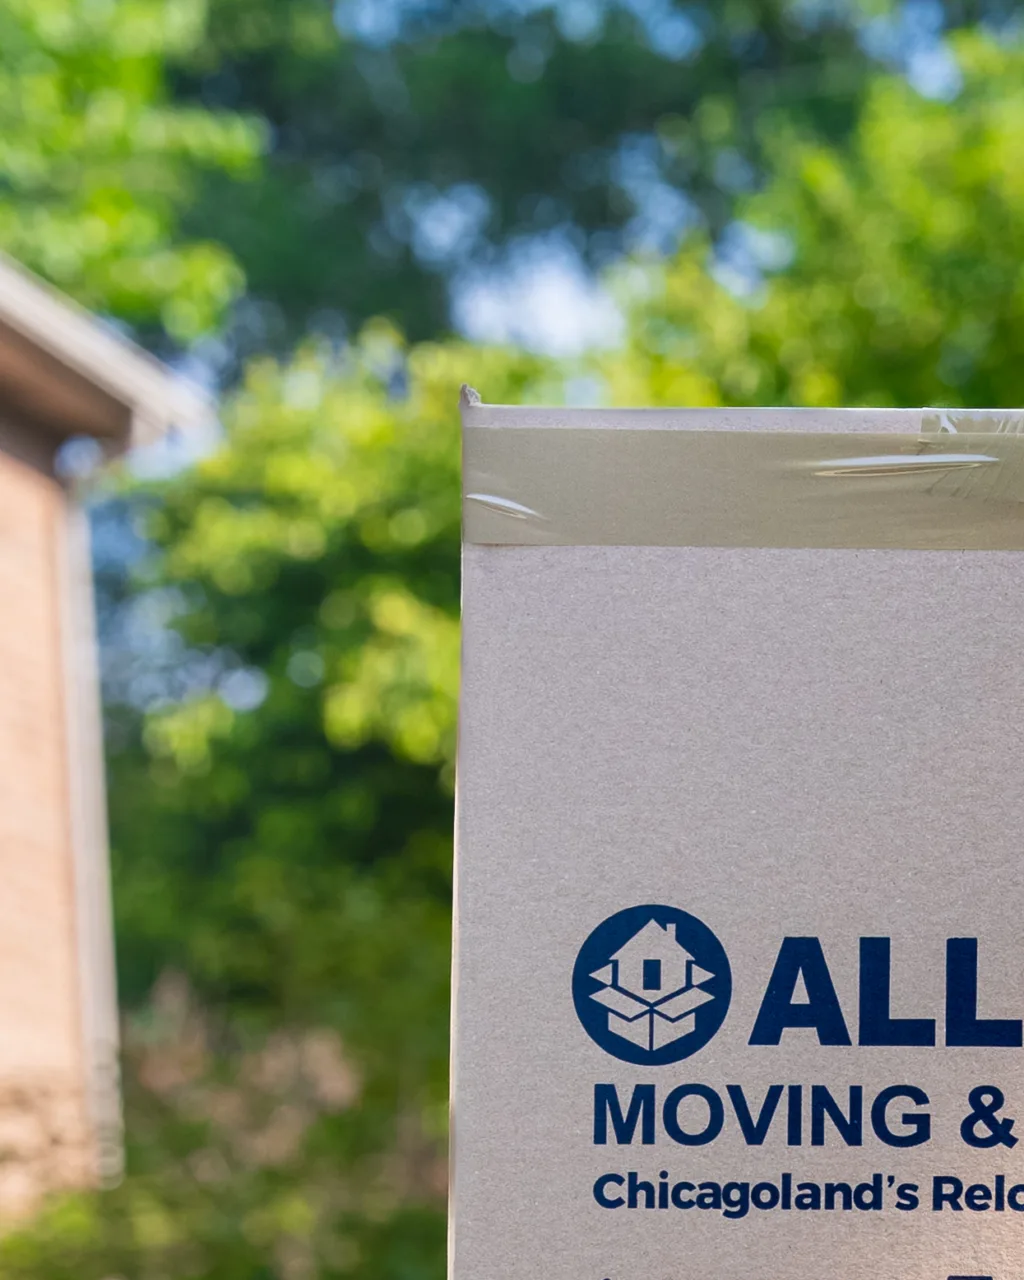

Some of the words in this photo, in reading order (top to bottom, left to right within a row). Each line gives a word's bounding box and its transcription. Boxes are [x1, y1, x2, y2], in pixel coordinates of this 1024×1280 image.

[592, 1083, 932, 1149] MOVING
[959, 1084, 1020, 1149] &
[592, 1169, 920, 1220] Chicagoland’s
